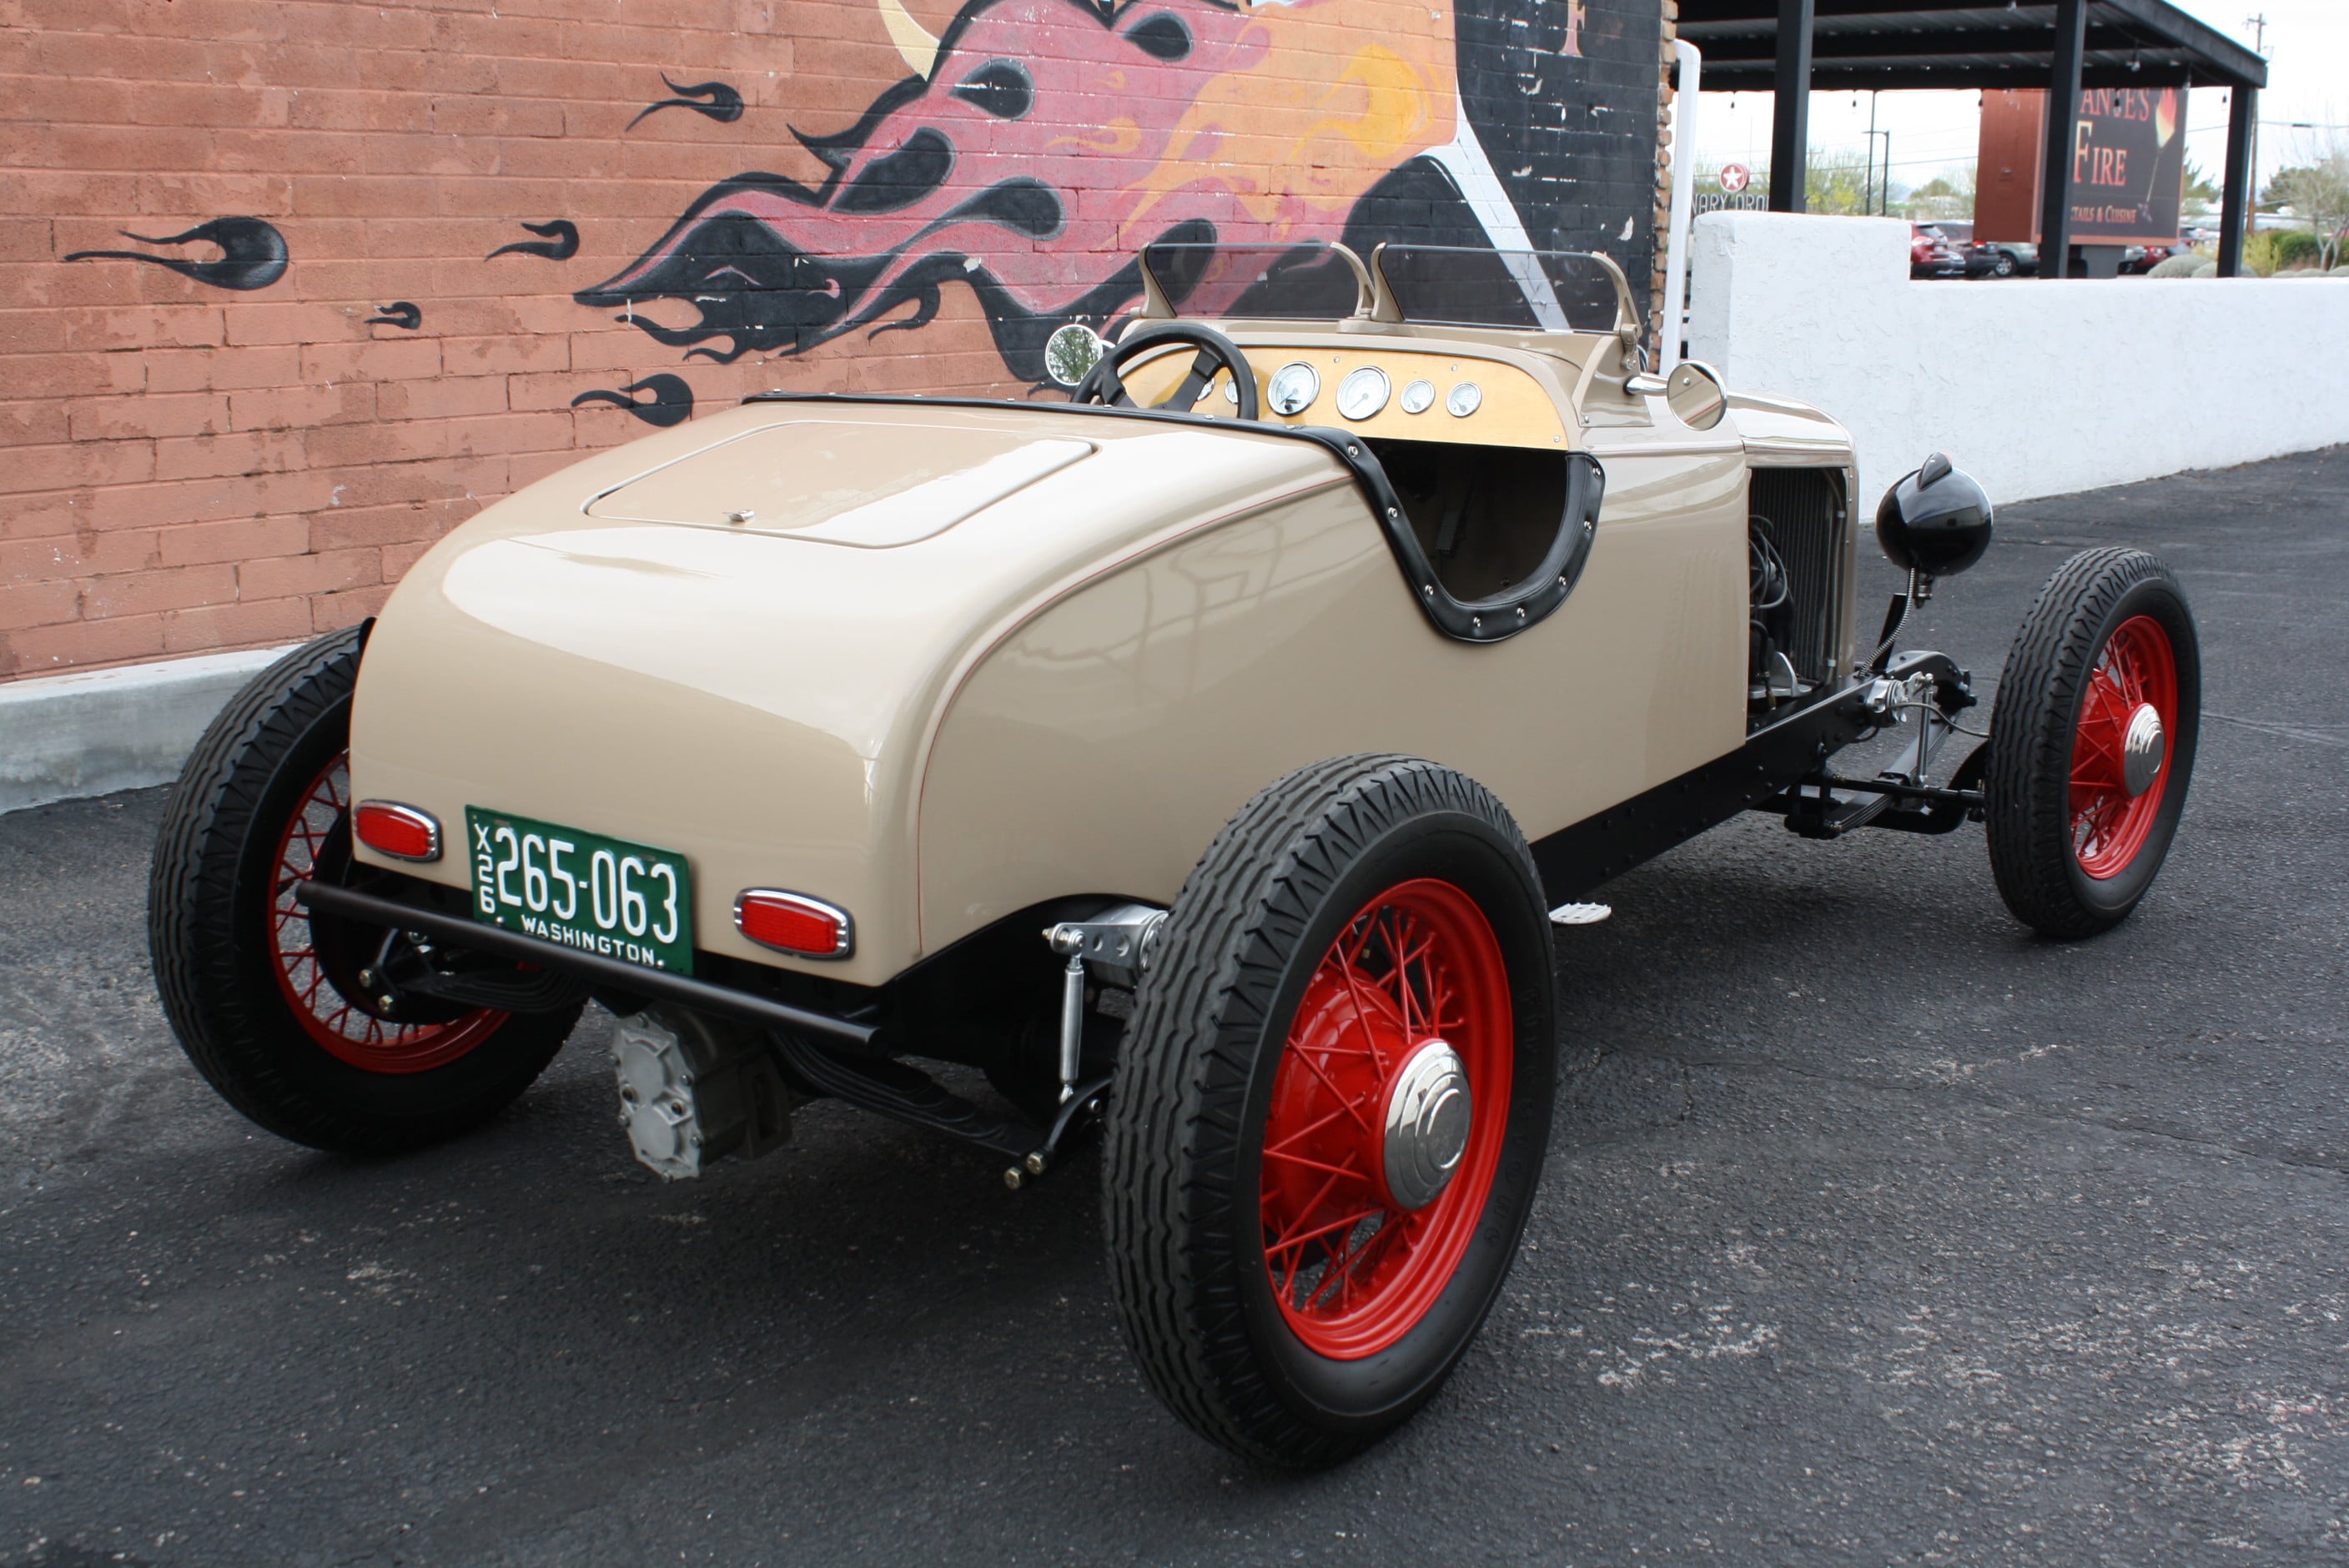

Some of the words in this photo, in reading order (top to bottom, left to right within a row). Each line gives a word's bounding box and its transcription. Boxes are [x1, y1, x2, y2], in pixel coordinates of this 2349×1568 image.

[2074, 120, 2127, 186] FIRE
[495, 827, 678, 944] 265-063
[521, 914, 655, 967] WASHINGTON
